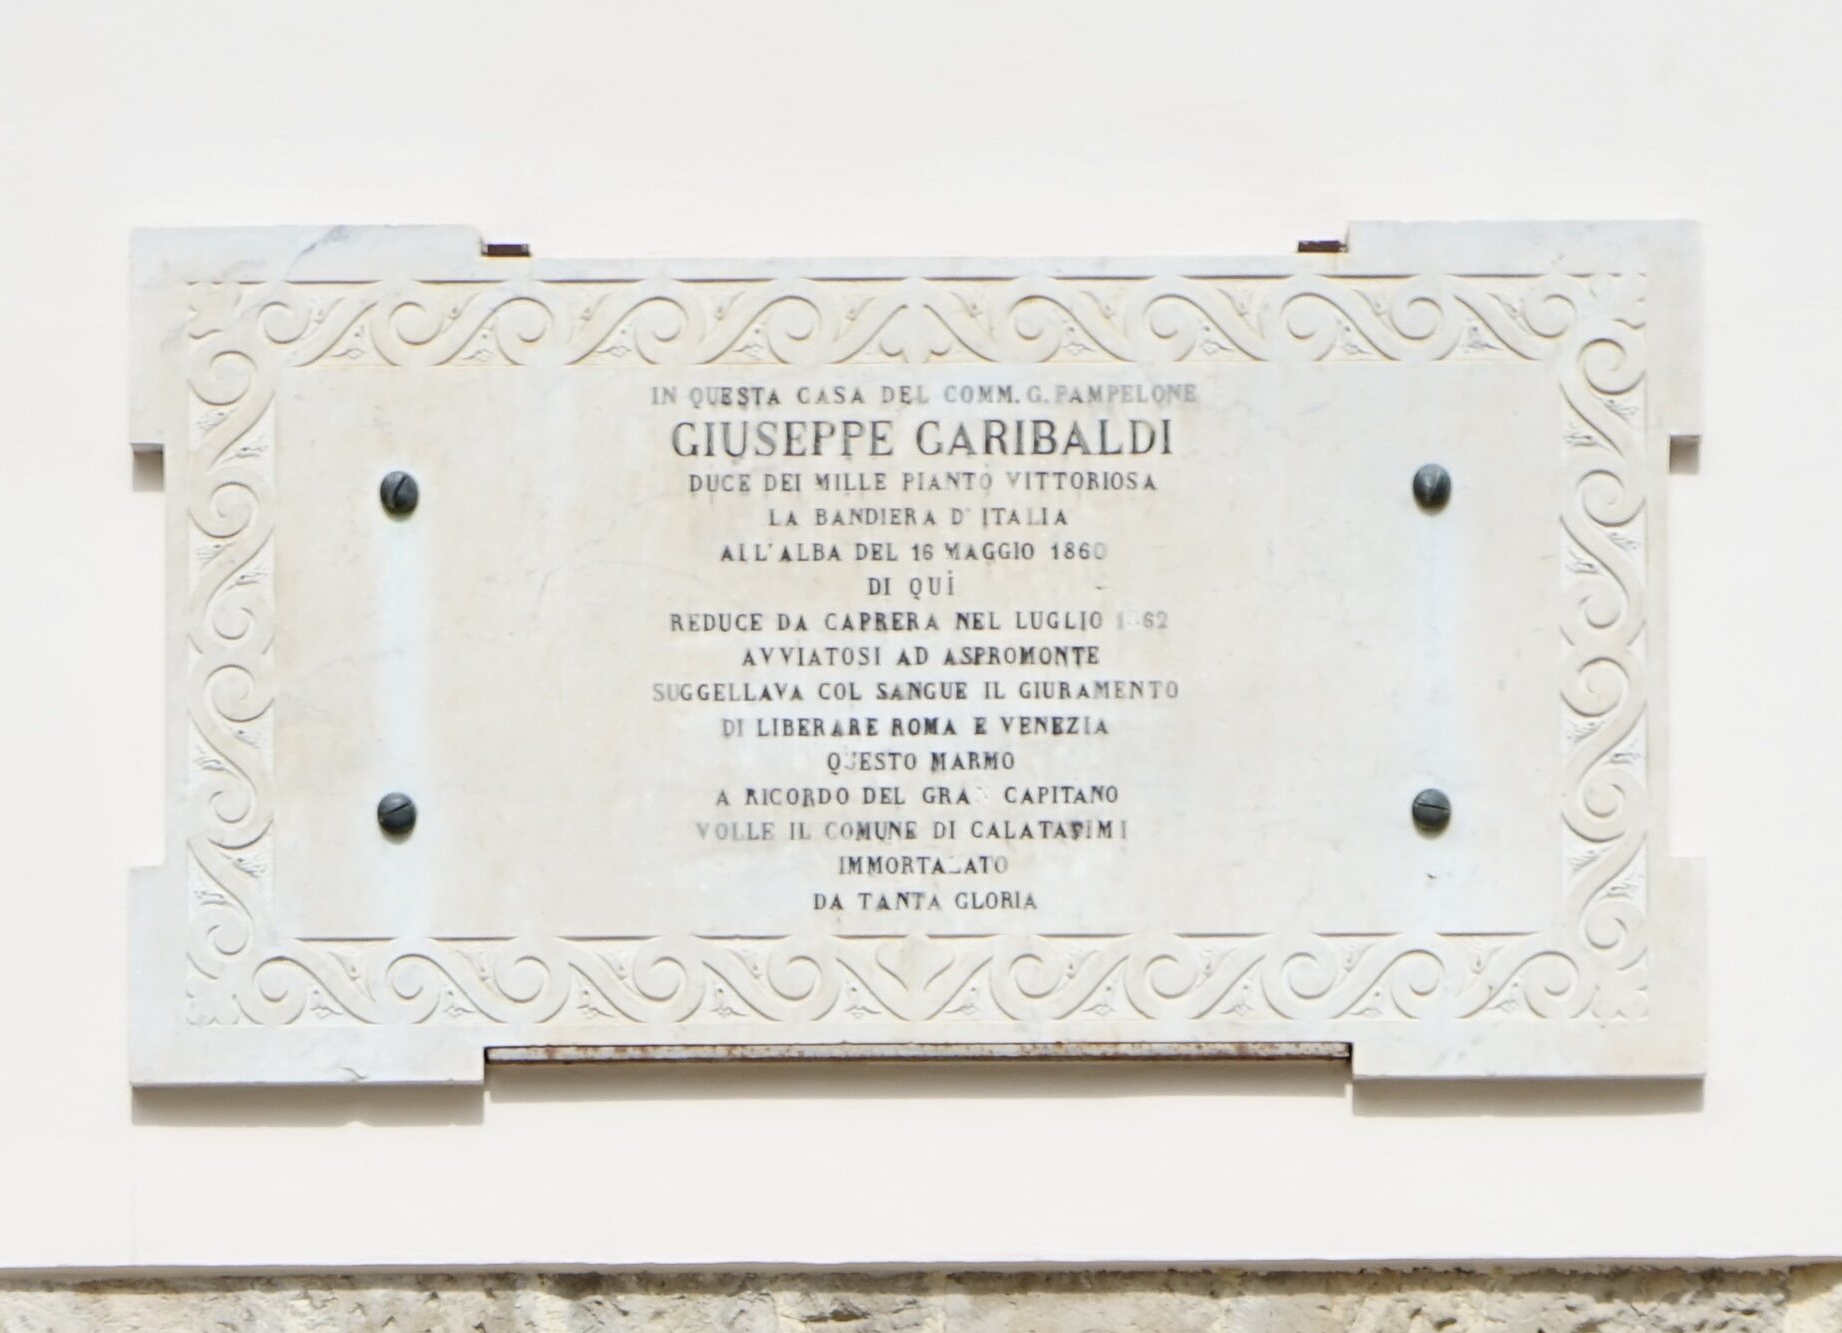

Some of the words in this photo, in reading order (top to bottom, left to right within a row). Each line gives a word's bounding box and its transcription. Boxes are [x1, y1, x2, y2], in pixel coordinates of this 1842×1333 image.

[651, 386, 677, 406] IN
[688, 385, 782, 410] QUESTA
[795, 385, 866, 405] CASA
[880, 384, 930, 406] DEL
[943, 384, 1021, 405] COMM.
[670, 419, 895, 459] GIUSEPPE
[914, 418, 1173, 457] GARIBALDI
[687, 473, 752, 494] DUCE
[763, 472, 802, 493] DEI
[814, 471, 887, 495] MILLE
[1005, 470, 1158, 492] VITTORIOSA
[767, 507, 800, 527] LA
[814, 506, 938, 527] BANDIERA
[854, 541, 899, 563] DEL
[910, 542, 935, 562] 16
[943, 540, 1036, 566] MAGGIO
[1050, 540, 1107, 561] 1860
[866, 576, 892, 597] DI
[669, 612, 763, 633] REDUCE
[777, 611, 809, 633] DA
[823, 610, 941, 633] CAPRERA
[953, 610, 1001, 631] NEL
[1014, 610, 1104, 633] LUGLIO
[1115, 610, 1169, 631] 162
[740, 645, 882, 668] AVVIATOSI
[894, 645, 930, 668] AD
[942, 645, 1101, 669] ASPROMONTE
[652, 681, 805, 703] SUGGELLAVA
[816, 681, 863, 702] COL
[875, 680, 969, 702] SANGUE
[982, 680, 1007, 701] IL
[1017, 679, 1179, 701] GIURAMENTO
[720, 717, 744, 740] DI
[755, 716, 880, 738] LIBERARE
[889, 716, 959, 738] ROMA
[972, 715, 989, 736] E
[998, 715, 1110, 738] VENEZIA
[929, 750, 1016, 775] MARMO
[715, 788, 732, 807] A
[744, 786, 851, 809] RICORDO
[861, 785, 907, 806] DEL
[921, 785, 983, 806] GRA
[1003, 784, 1119, 805] CAPITANO
[694, 821, 775, 842] VOLLE
[788, 821, 812, 841] IL
[824, 820, 918, 843] COMUNE
[932, 819, 957, 841] DI
[969, 819, 1128, 842] CALATAFIMI
[812, 892, 845, 912] DA
[856, 891, 943, 912] TANTA
[953, 890, 1039, 911] GLORIA
